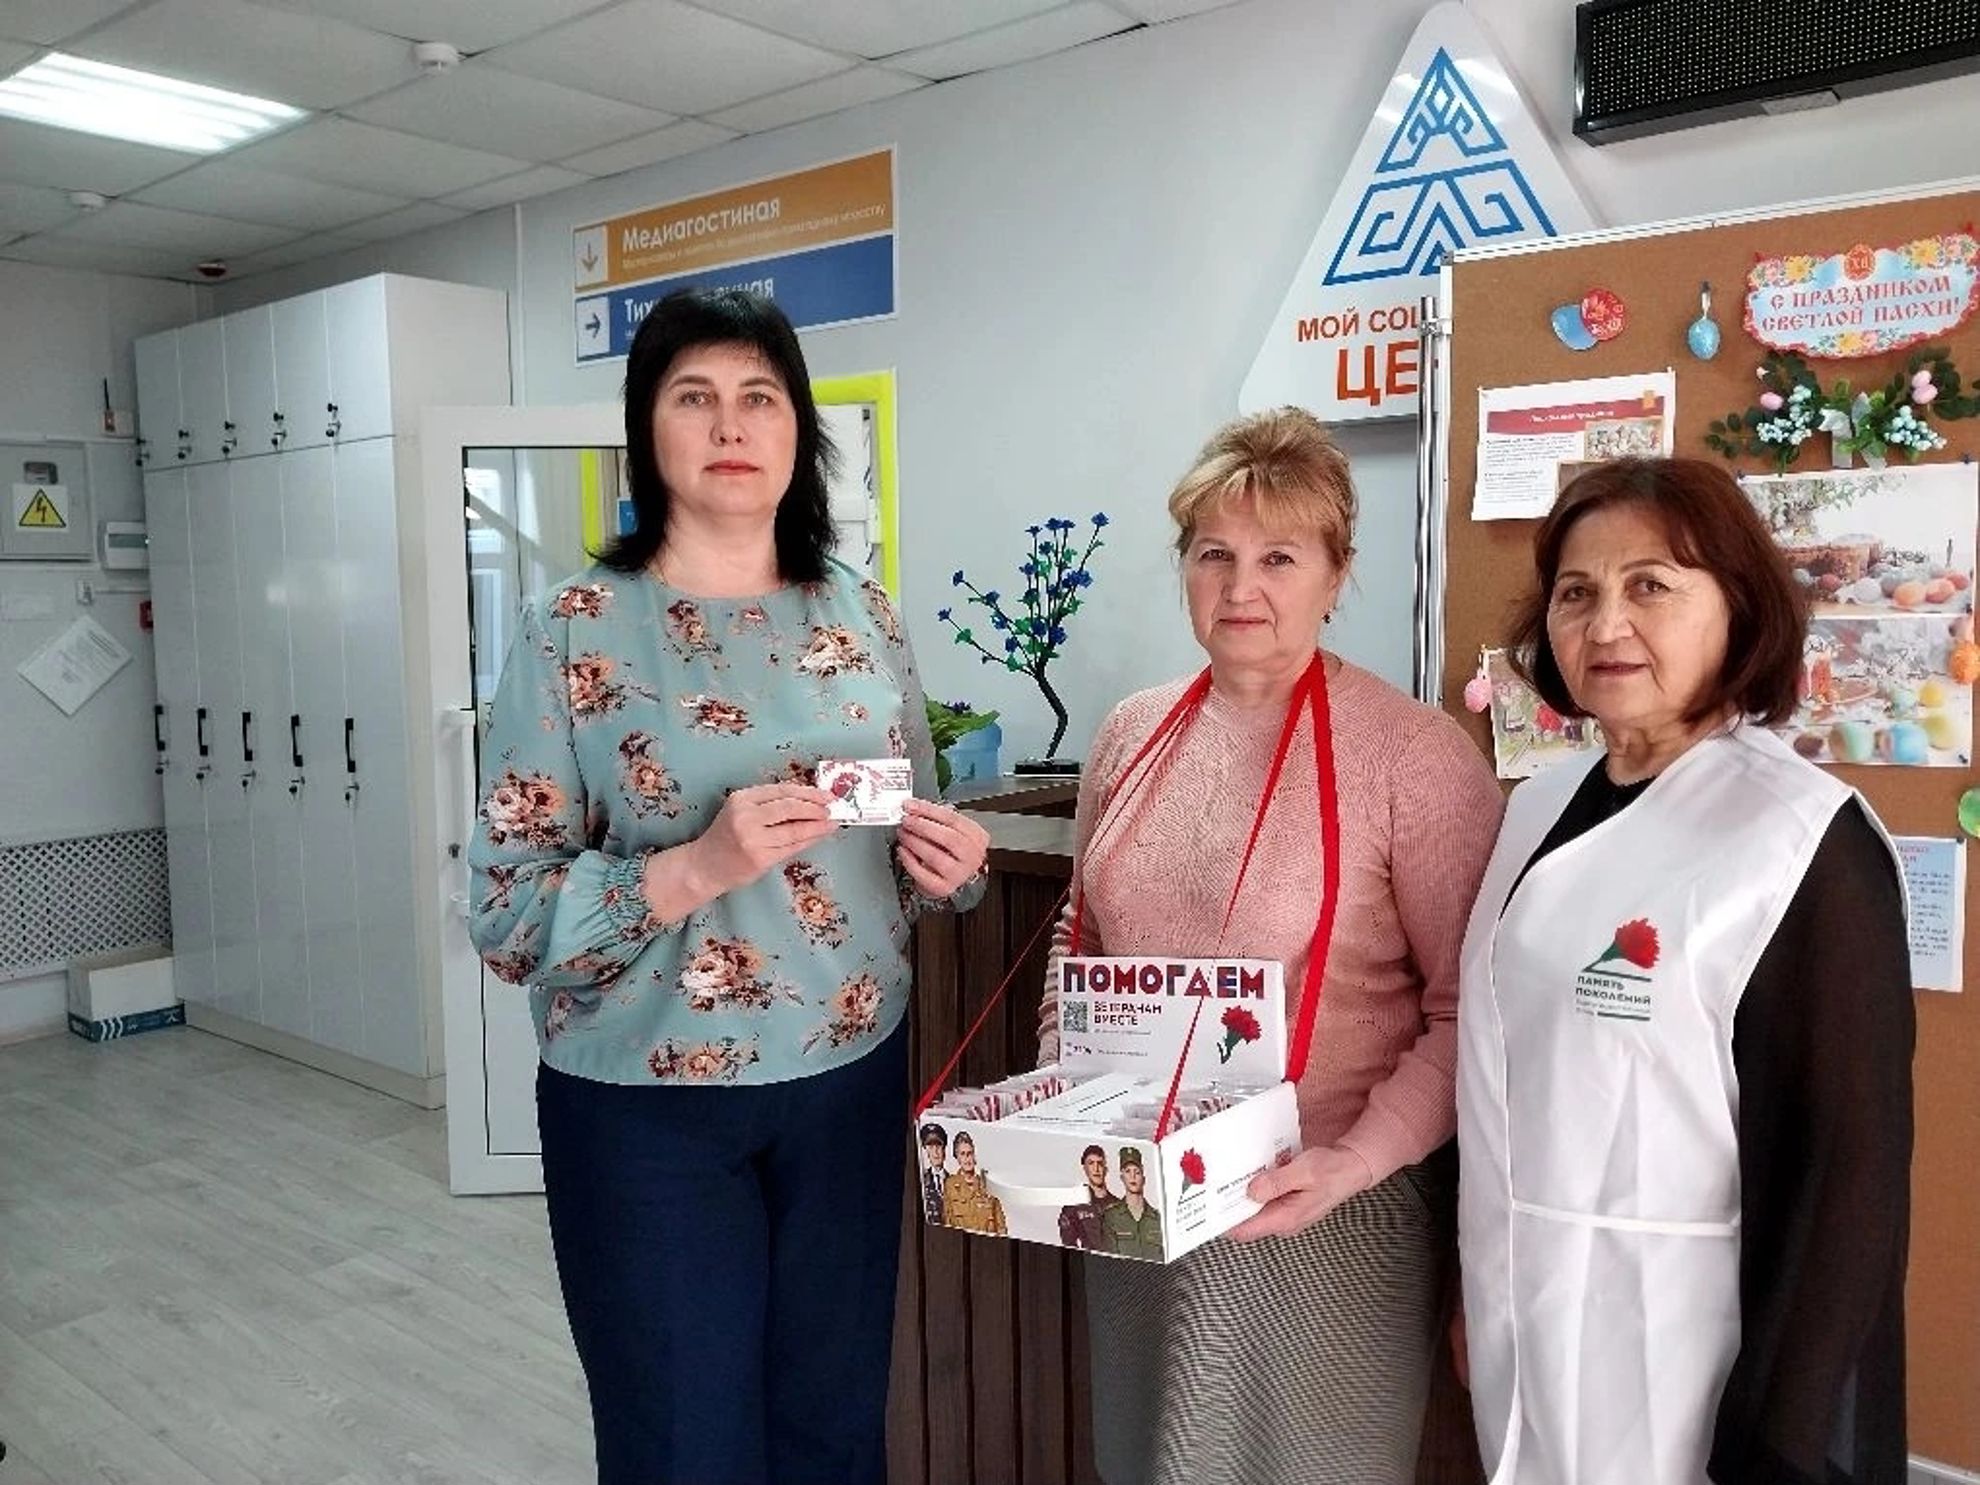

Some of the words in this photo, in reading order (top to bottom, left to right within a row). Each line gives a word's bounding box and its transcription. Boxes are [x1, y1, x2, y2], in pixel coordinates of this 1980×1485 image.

[622, 198, 780, 254] Медиагостиная
[1771, 294, 1785, 311] С
[1792, 275, 1951, 306] ПРАЗДНИКОМ
[1297, 306, 1360, 342] МОЙ
[1761, 306, 1864, 332] СВЕТЛОЙ
[1873, 298, 1960, 323] ПАСХИ!
[1063, 962, 1265, 999] ПОМОГАЕМ
[1577, 975, 1625, 991] ПАМЯТЬ
